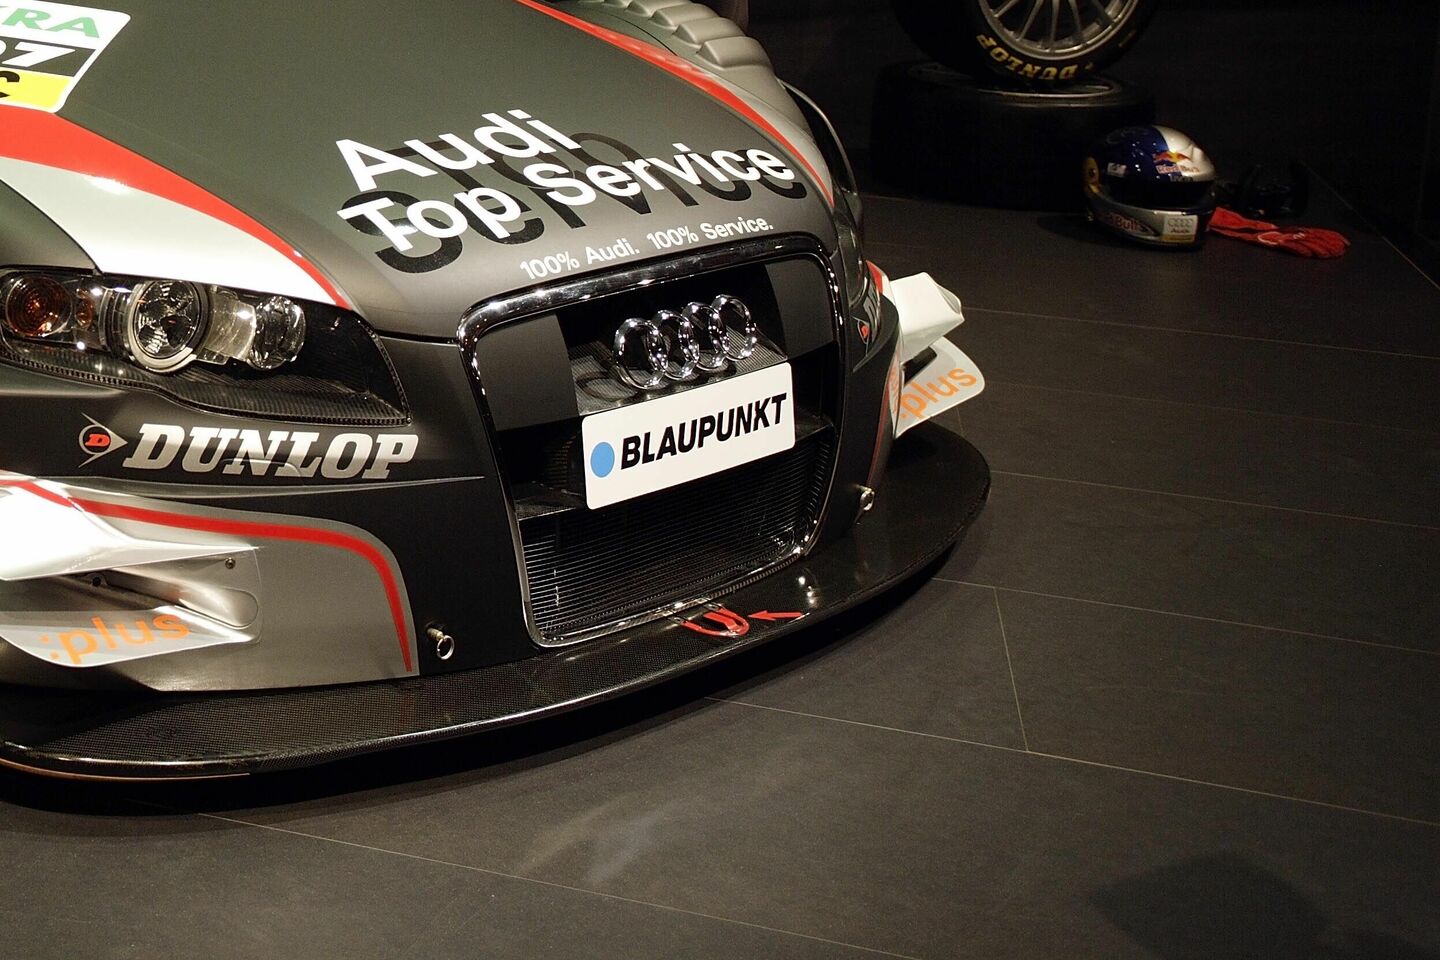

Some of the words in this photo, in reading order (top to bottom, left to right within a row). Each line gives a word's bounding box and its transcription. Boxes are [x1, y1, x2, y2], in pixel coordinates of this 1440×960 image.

[975, 33, 1079, 80] DUNLOP
[335, 109, 582, 193] Audi
[338, 185, 523, 252] Top
[522, 143, 796, 207] Service
[520, 251, 580, 281] 100%
[585, 237, 640, 265] Audi.
[646, 225, 699, 251] 100%
[700, 216, 774, 240] Service.
[122, 423, 419, 480] DUNLOP
[621, 392, 787, 470] BLAUPUNKT
